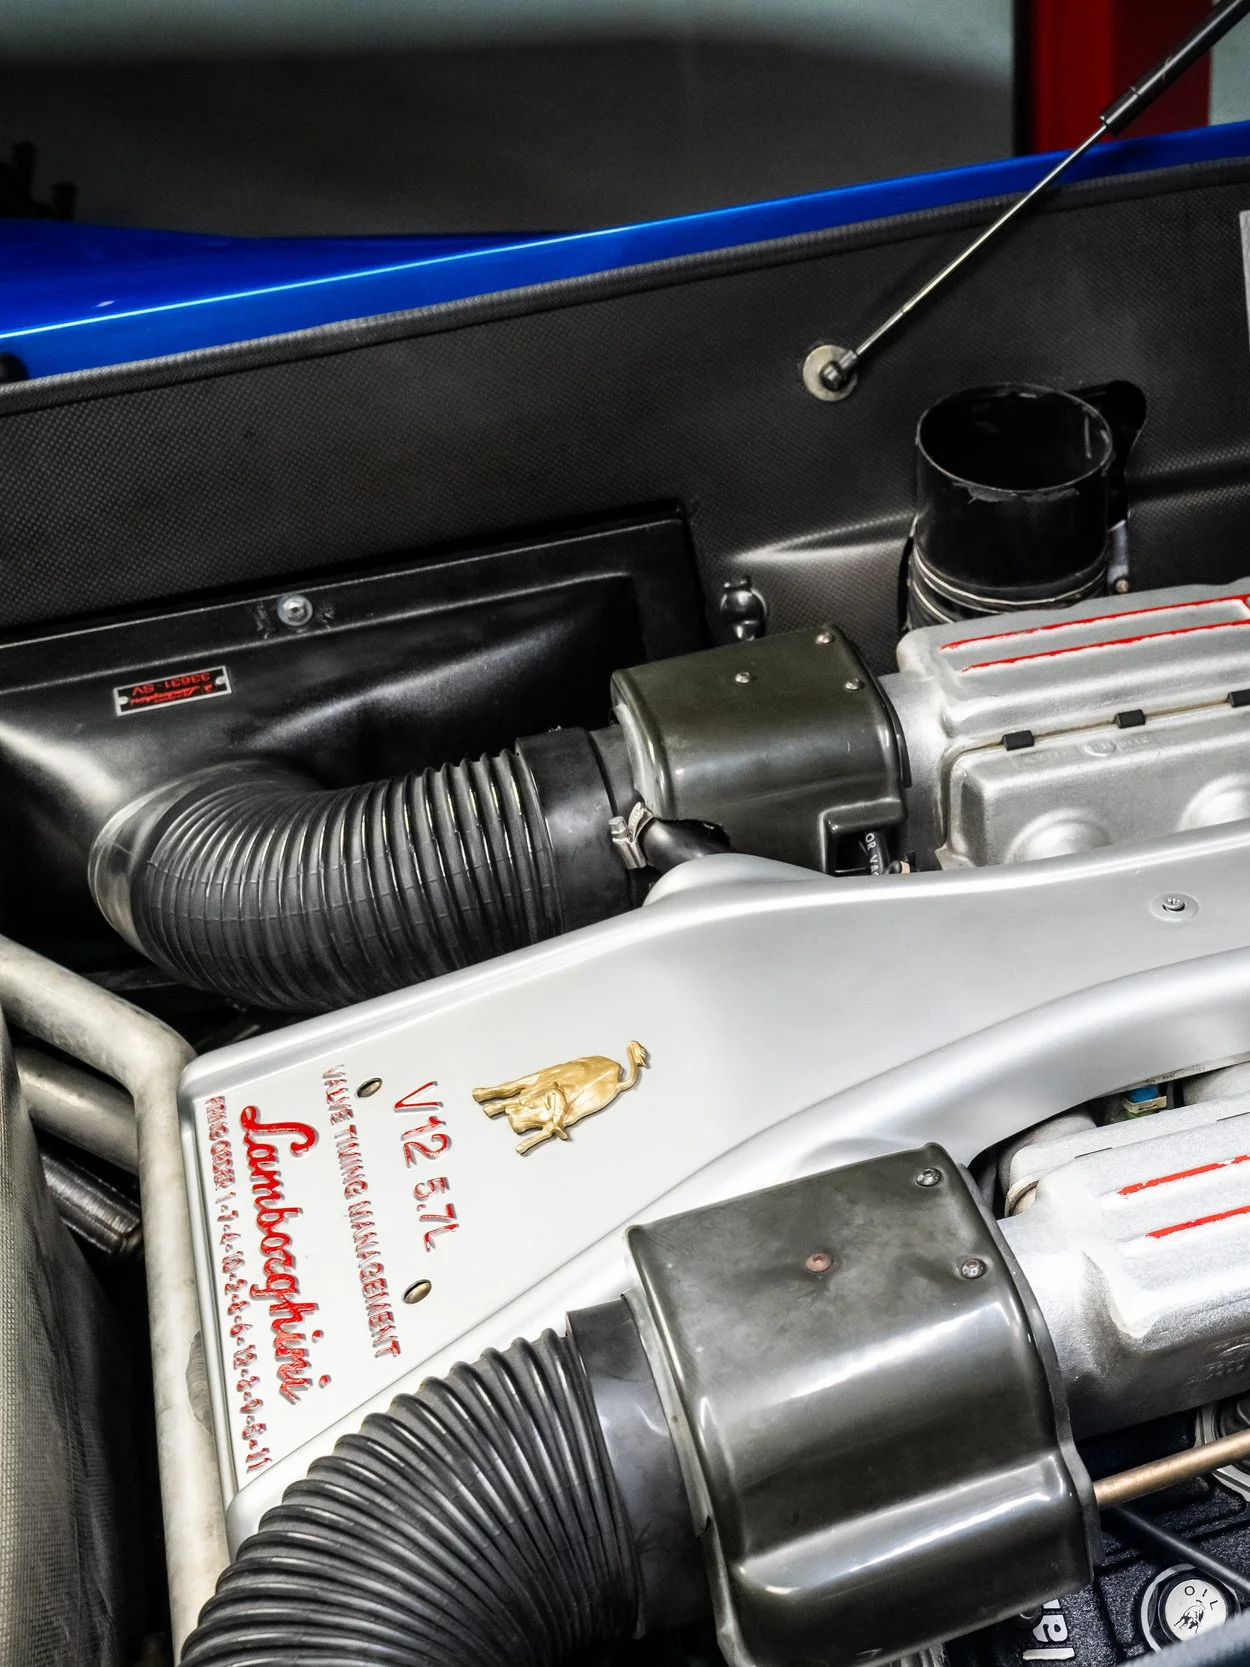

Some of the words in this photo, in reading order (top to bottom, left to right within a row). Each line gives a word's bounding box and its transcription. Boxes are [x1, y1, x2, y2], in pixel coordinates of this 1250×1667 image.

[323, 1064, 354, 1125] VALVE
[394, 1080, 451, 1168] V12
[335, 1124, 368, 1199] TIMING
[413, 1176, 460, 1253] 5.7L
[240, 1105, 332, 1406] Lamborghini
[347, 1201, 401, 1357] MANAGEMENT
[1184, 1586, 1219, 1611] OIL
